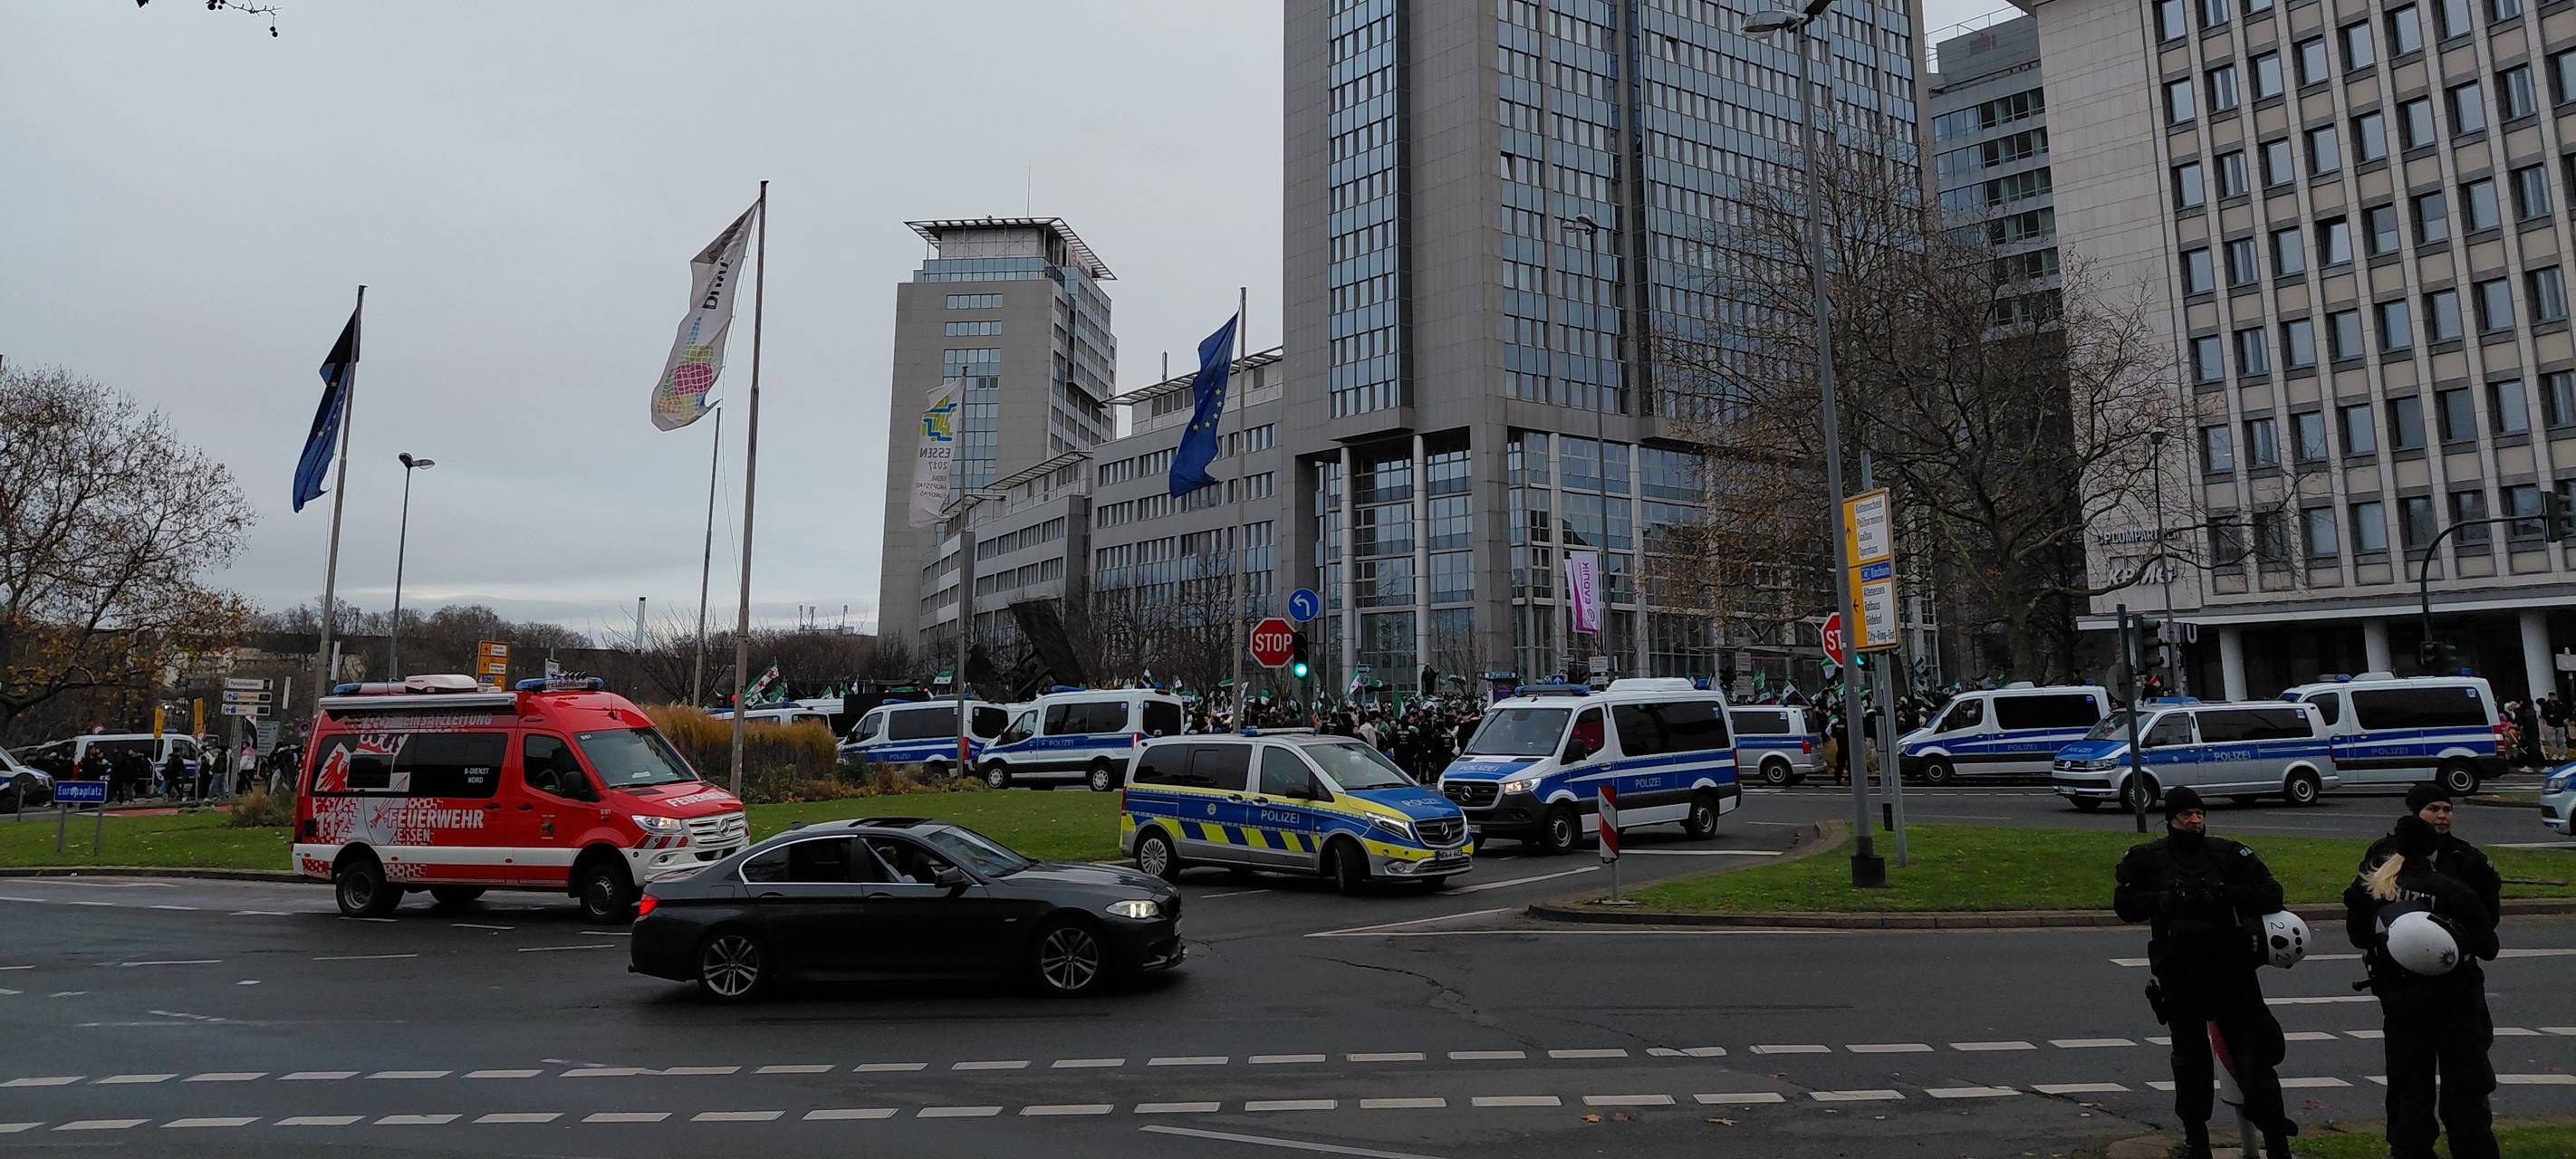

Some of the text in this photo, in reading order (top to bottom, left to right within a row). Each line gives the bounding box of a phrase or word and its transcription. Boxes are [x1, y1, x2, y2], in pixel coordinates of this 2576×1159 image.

[2187, 624, 2197, 644] U
[1255, 634, 1293, 652] STOP
[404, 714, 493, 726] EINSATZLEITUNG
[2065, 745, 2094, 753] POLIZEI
[2371, 746, 2408, 755] POLIZEI
[2214, 751, 2252, 761] POLIZEI
[1457, 764, 1500, 772] POLIZEI
[1634, 777, 1662, 790] POLIZEI
[58, 785, 102, 799] Europaplatz
[1400, 797, 1442, 807] POLIZE
[387, 809, 484, 829] FEUERWEHR
[1260, 809, 1301, 824] POLIZEI
[316, 811, 350, 838] 112
[397, 829, 431, 842] ESSEN
